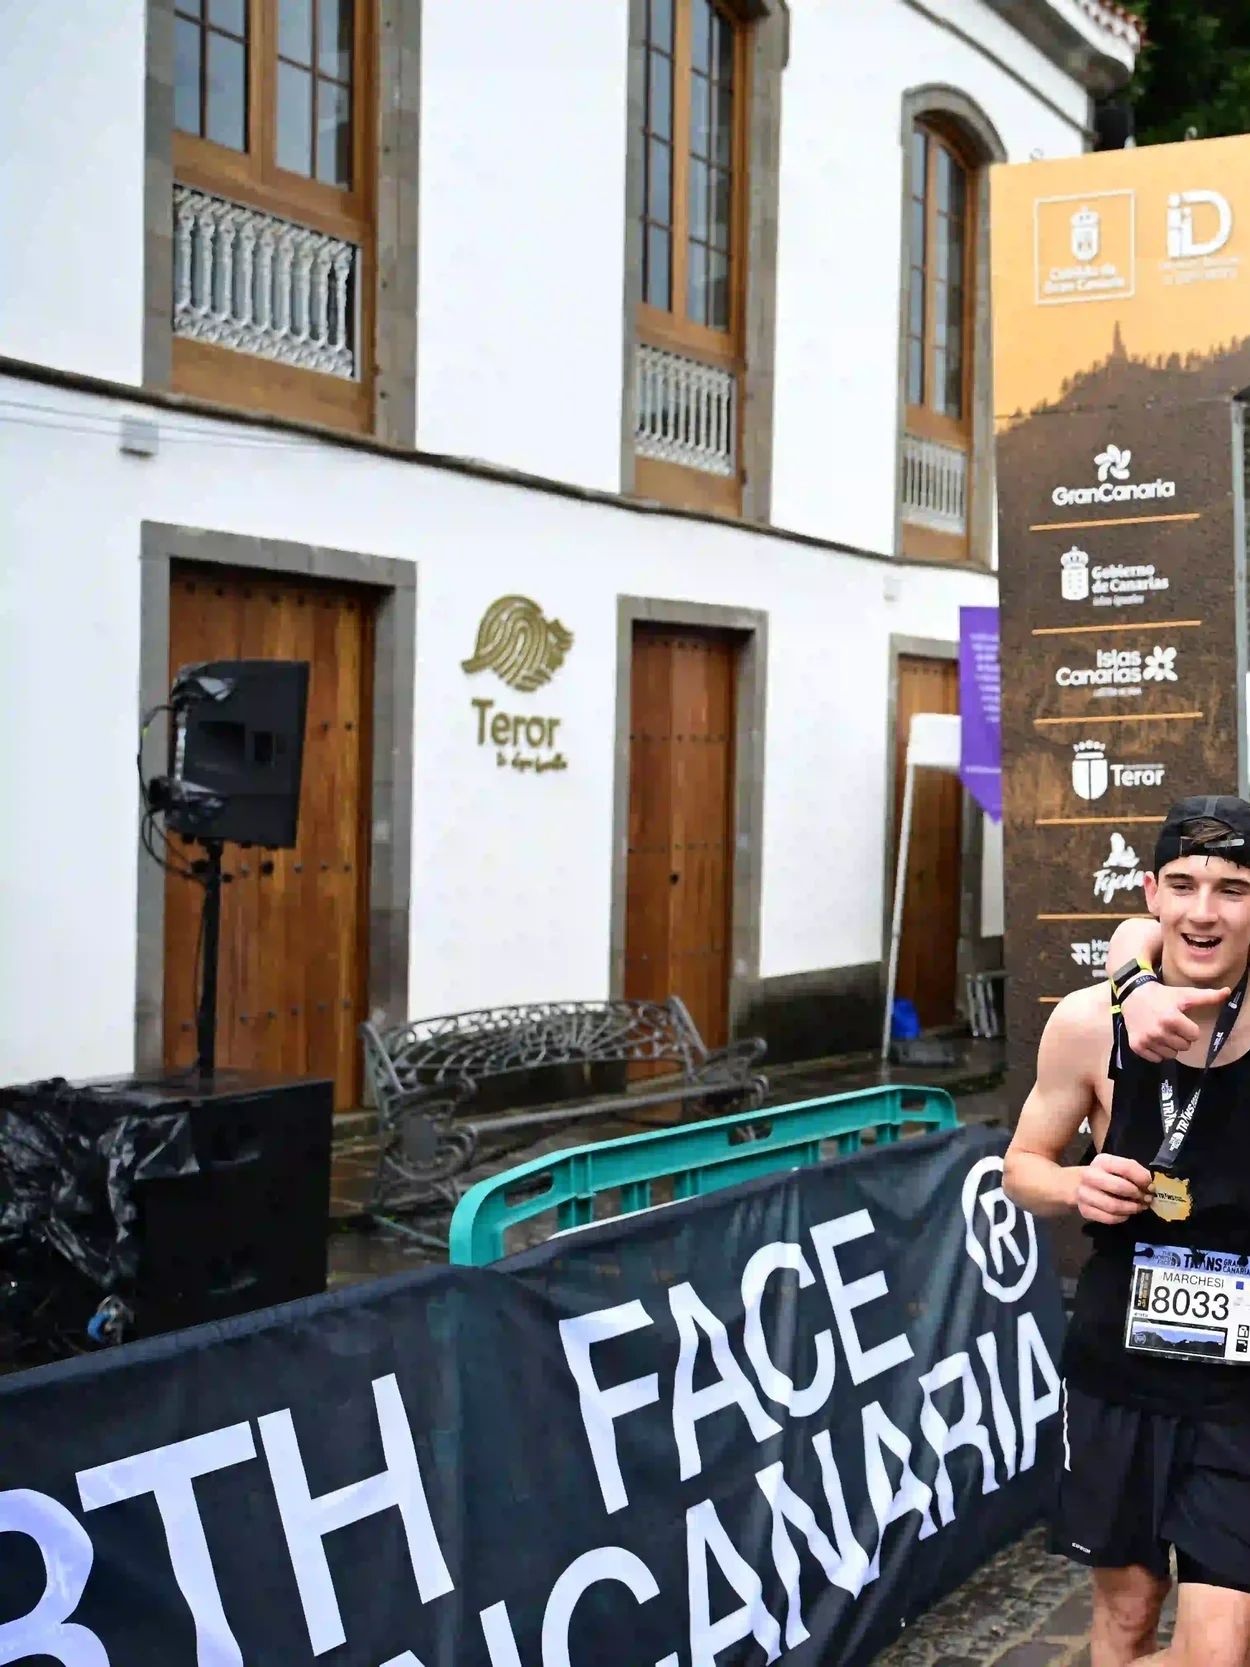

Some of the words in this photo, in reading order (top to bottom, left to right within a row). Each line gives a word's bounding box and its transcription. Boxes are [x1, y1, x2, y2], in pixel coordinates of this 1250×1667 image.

[1097, 649, 1142, 669] Islas
[1055, 664, 1142, 687] Canarias
[471, 697, 561, 749] Teror
[1110, 764, 1165, 787] Teror
[1162, 1272, 1225, 1288] MARCHESI
[1223, 1265, 1250, 1276] CANARIA
[1151, 1286, 1230, 1321] 8033
[559, 1209, 915, 1514] FACE
